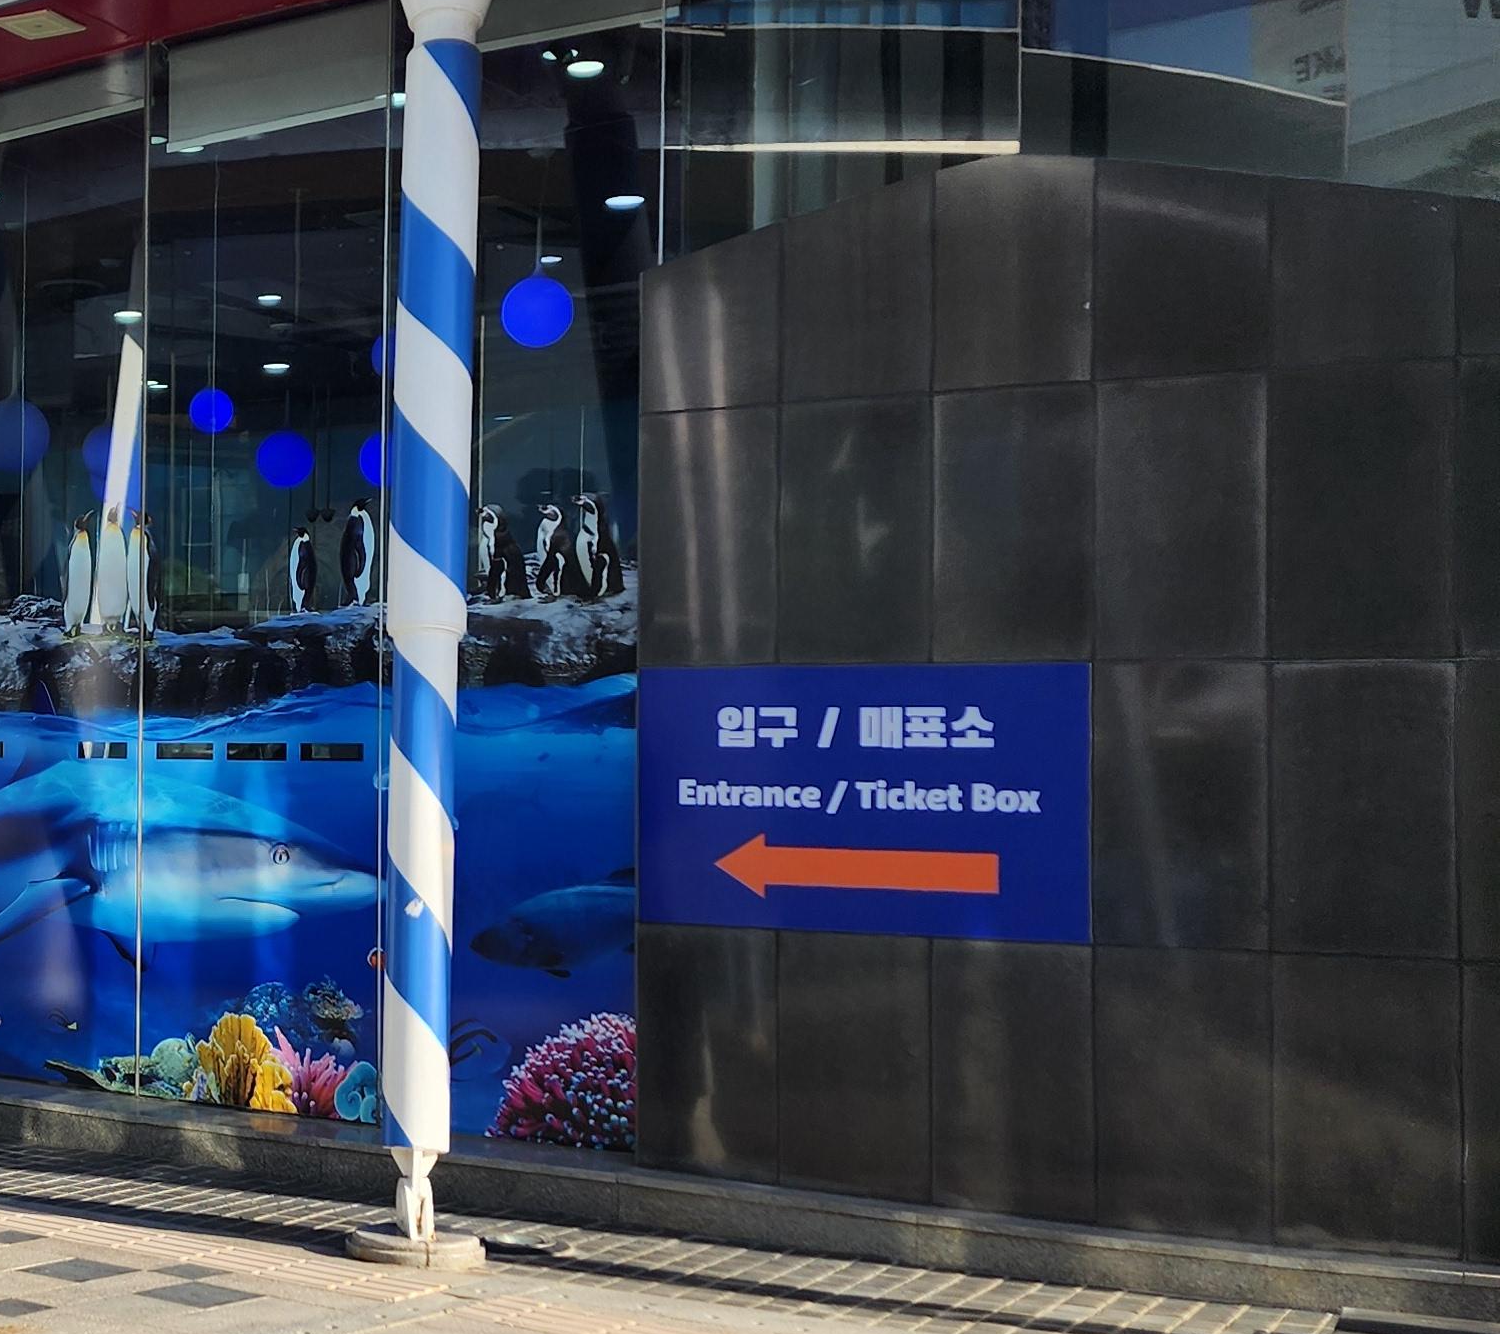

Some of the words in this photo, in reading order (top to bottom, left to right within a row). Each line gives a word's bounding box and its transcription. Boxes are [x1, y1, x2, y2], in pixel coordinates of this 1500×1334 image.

[717, 706, 799, 748] 입구
[816, 707, 840, 748] /
[858, 706, 995, 748] 매표소
[678, 778, 822, 810] Entrance
[825, 780, 849, 815] /
[855, 781, 963, 813] Ticket
[970, 782, 1042, 814] Box
